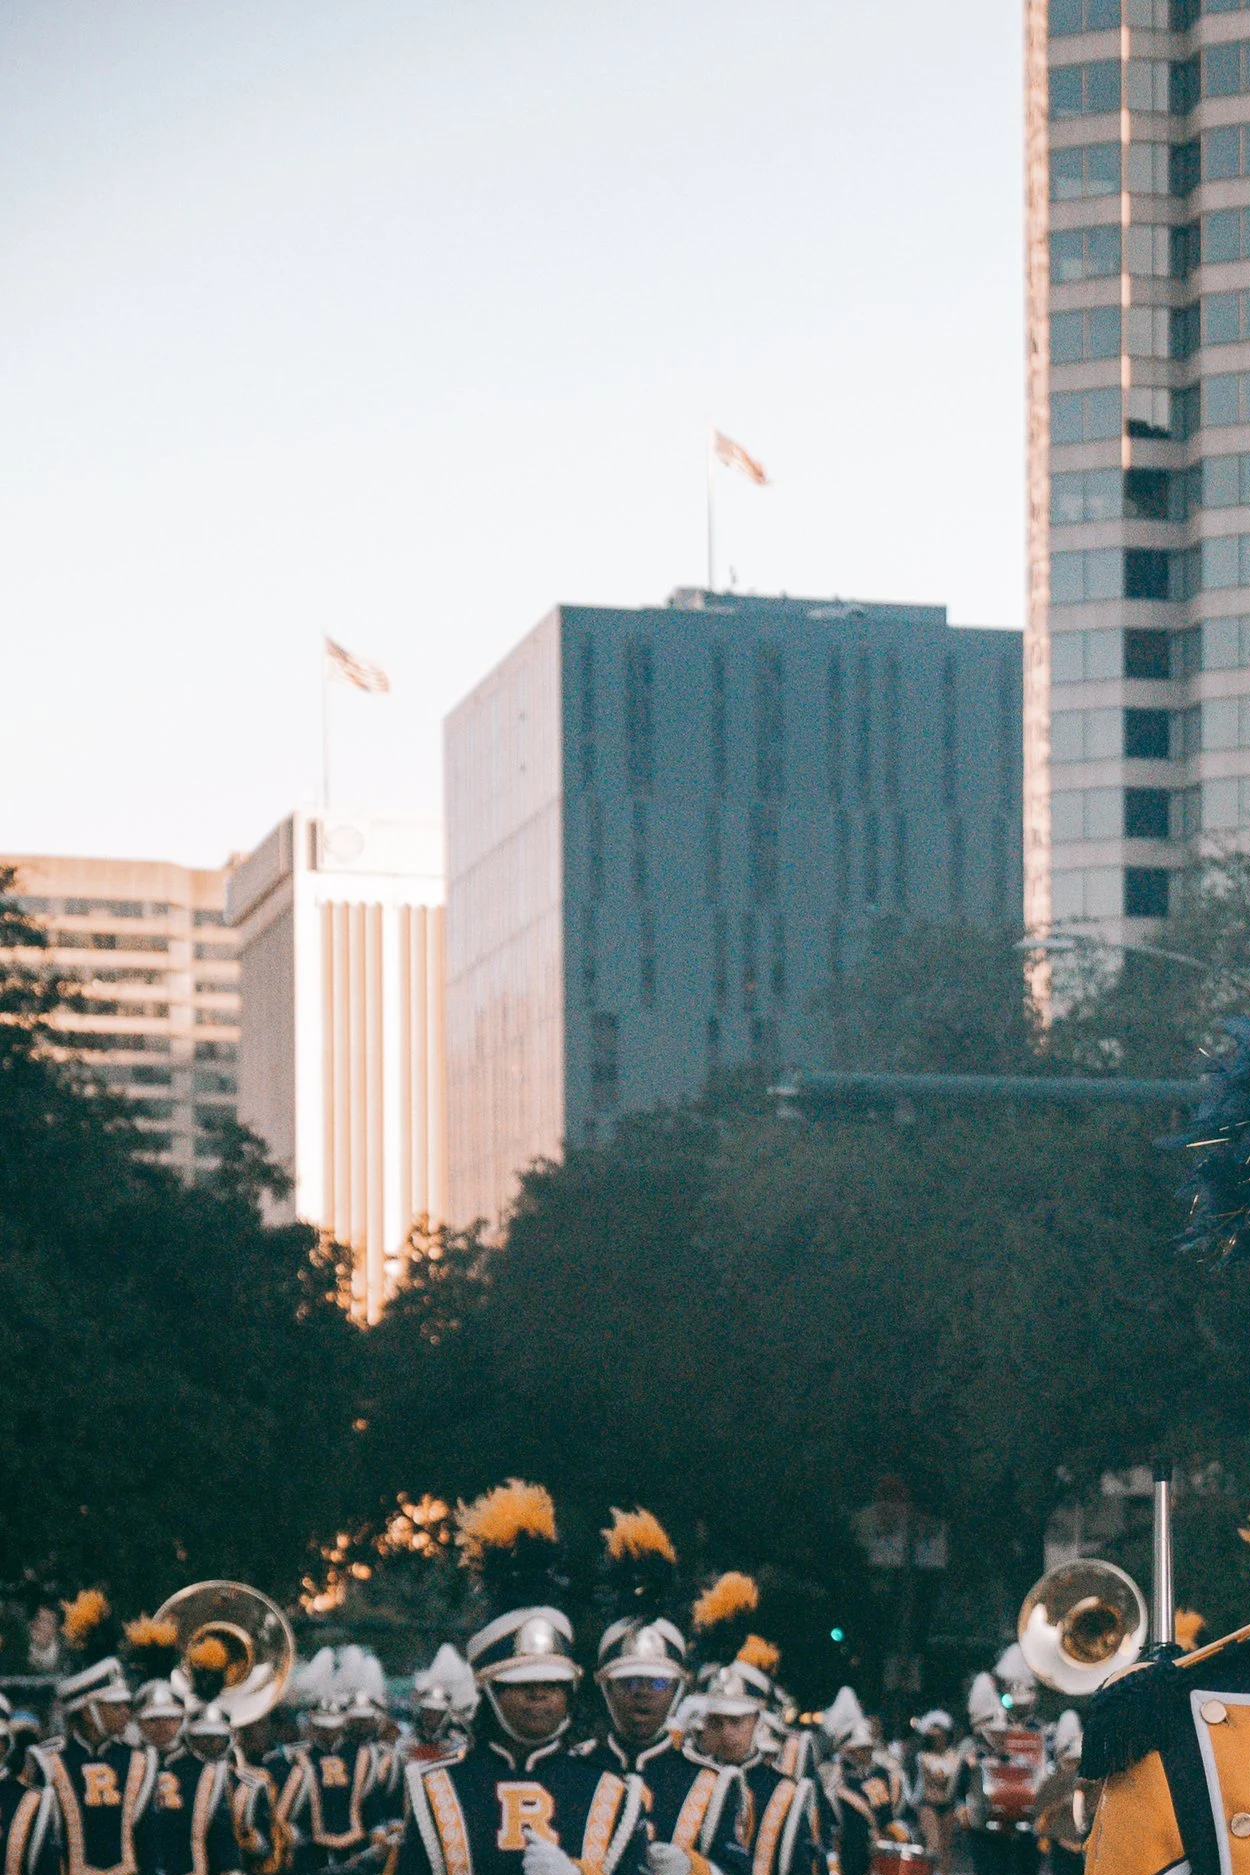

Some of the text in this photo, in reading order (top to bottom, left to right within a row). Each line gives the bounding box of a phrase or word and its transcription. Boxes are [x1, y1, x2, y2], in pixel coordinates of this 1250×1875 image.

[81, 1762, 122, 1806] R
[155, 1771, 183, 1809] R
[496, 1781, 560, 1851] R
